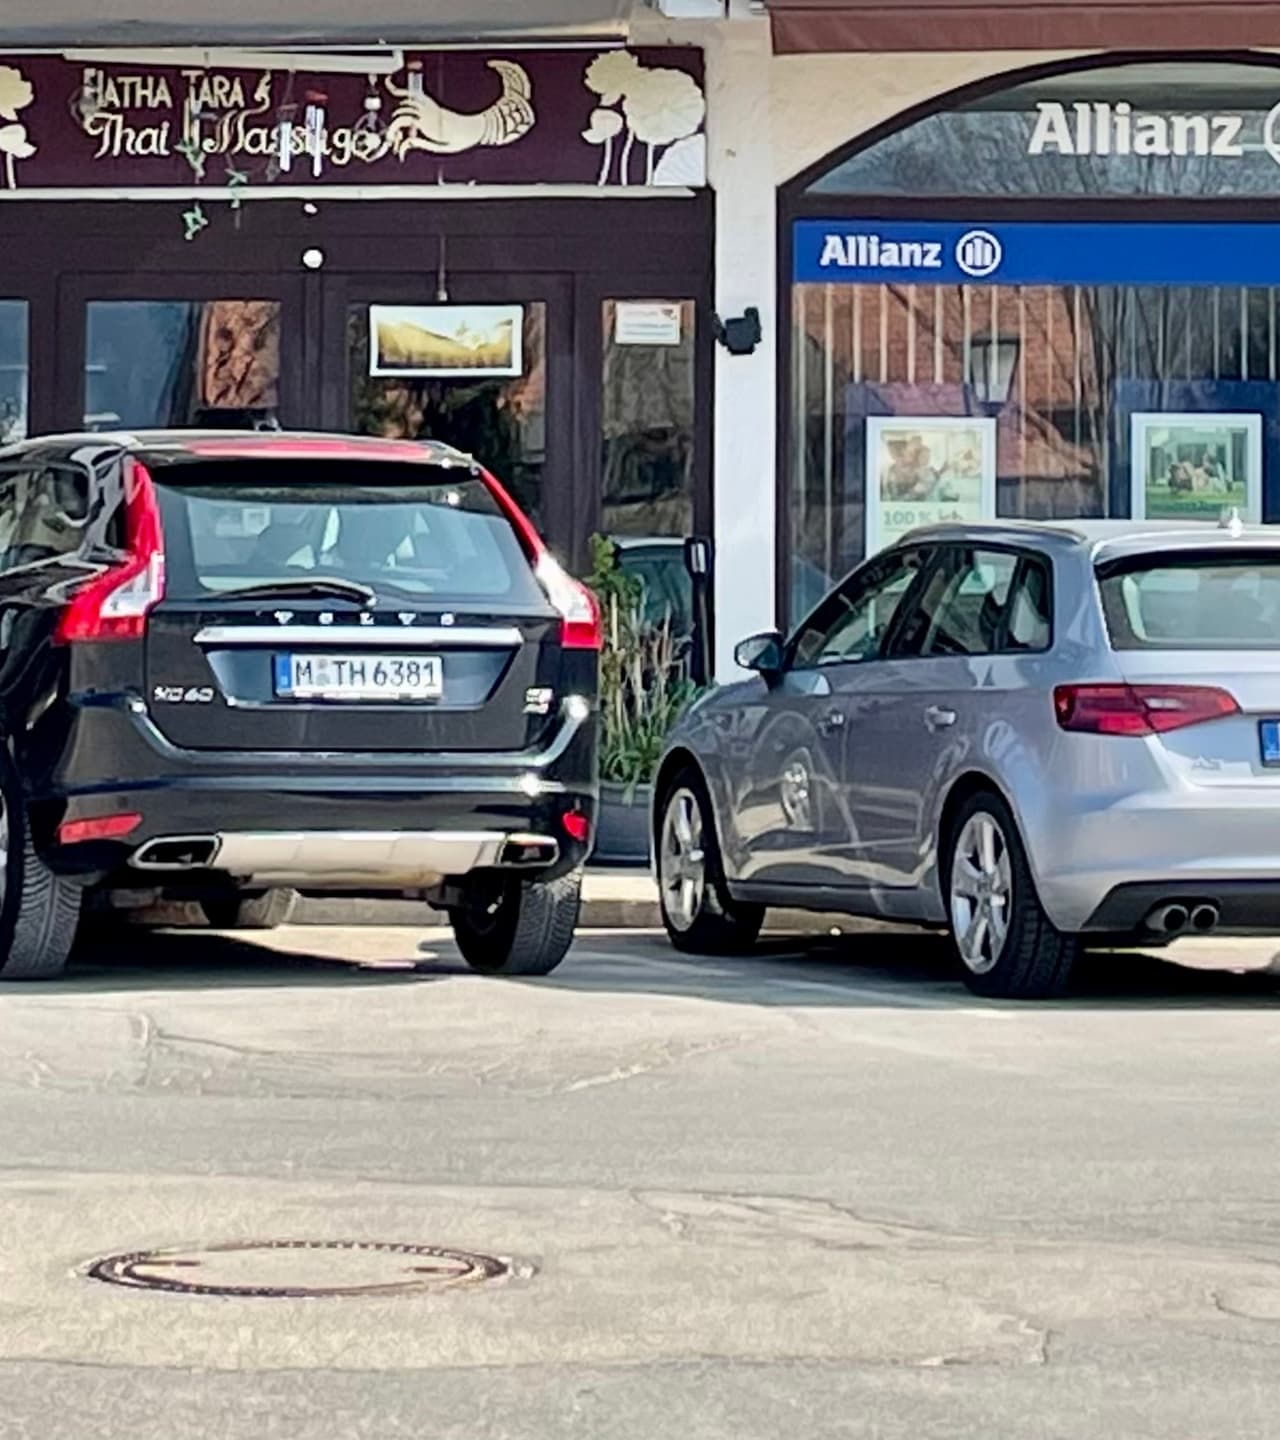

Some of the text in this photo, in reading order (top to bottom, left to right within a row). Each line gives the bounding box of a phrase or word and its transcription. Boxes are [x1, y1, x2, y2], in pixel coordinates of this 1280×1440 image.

[83, 67, 245, 109] HATHA TARA
[84, 108, 383, 166] Thai Massge
[1027, 101, 1244, 156] Allianz
[820, 234, 942, 268] Allianz
[273, 610, 456, 626] VOLVO
[294, 661, 438, 688] M TH 6381
